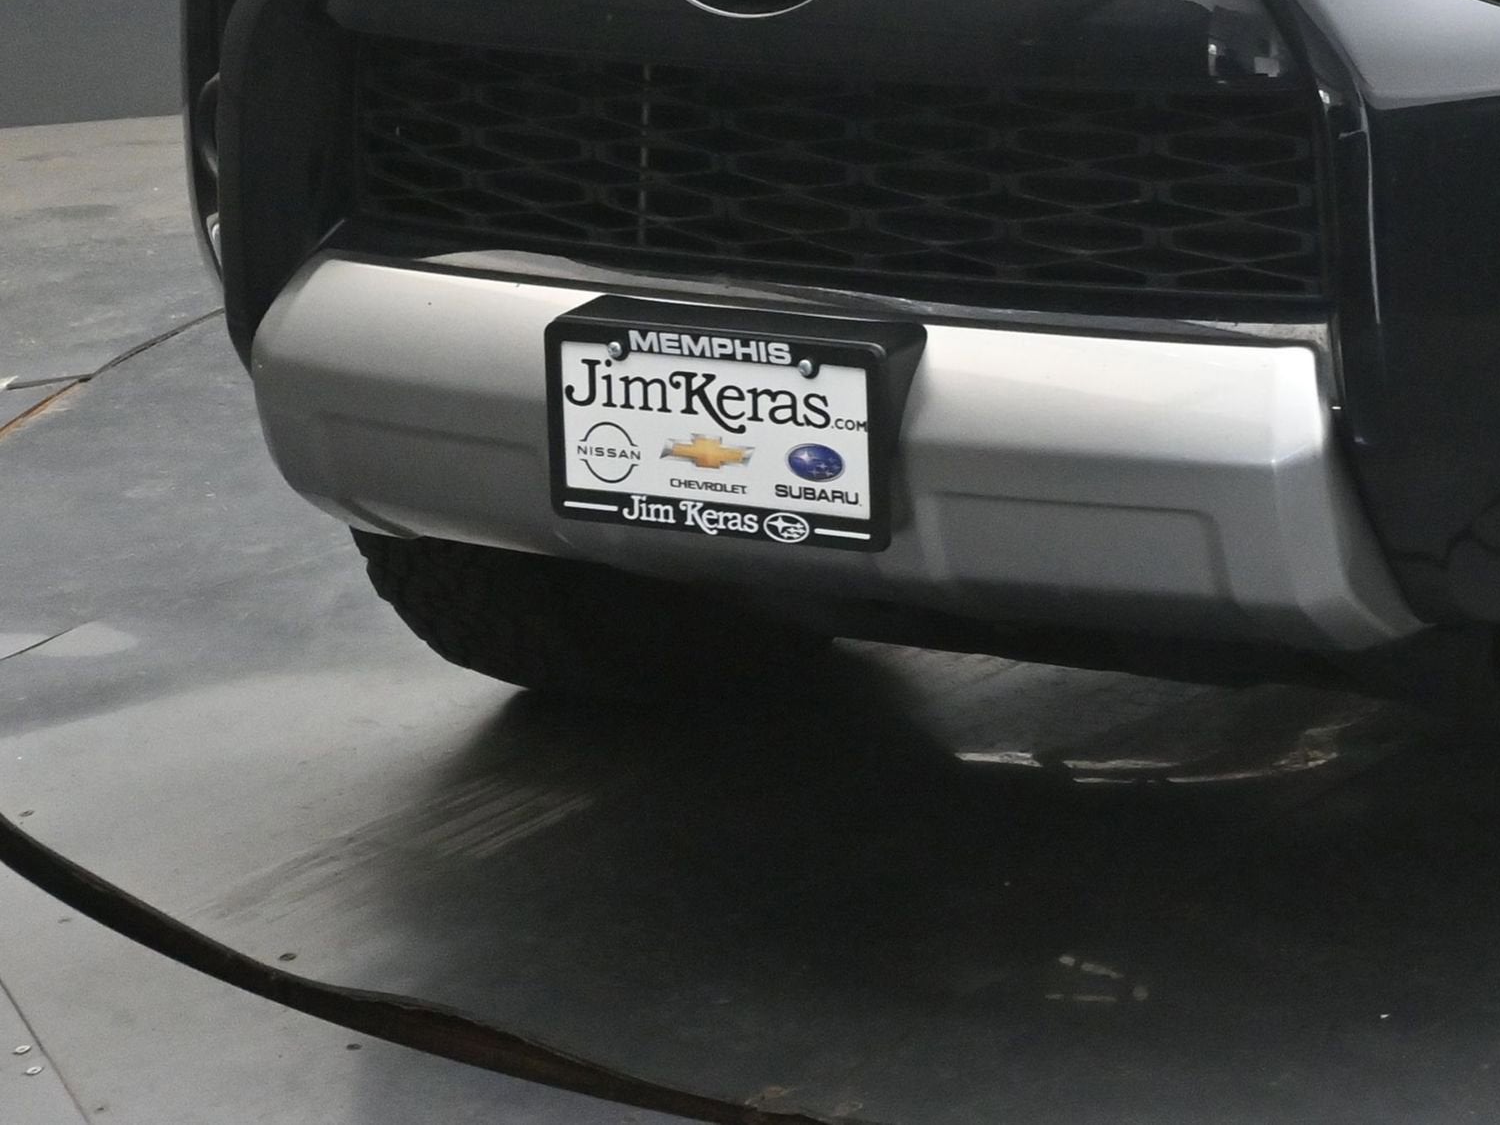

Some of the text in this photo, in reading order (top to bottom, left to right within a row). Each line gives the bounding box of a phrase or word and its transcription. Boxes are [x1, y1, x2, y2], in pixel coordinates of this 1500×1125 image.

[628, 329, 792, 365] MEMPHIS
[577, 445, 641, 461] NISSAN
[669, 478, 748, 495] CHEVROLET
[775, 484, 859, 505] SUBARU
[622, 495, 759, 535] Jim Keras
